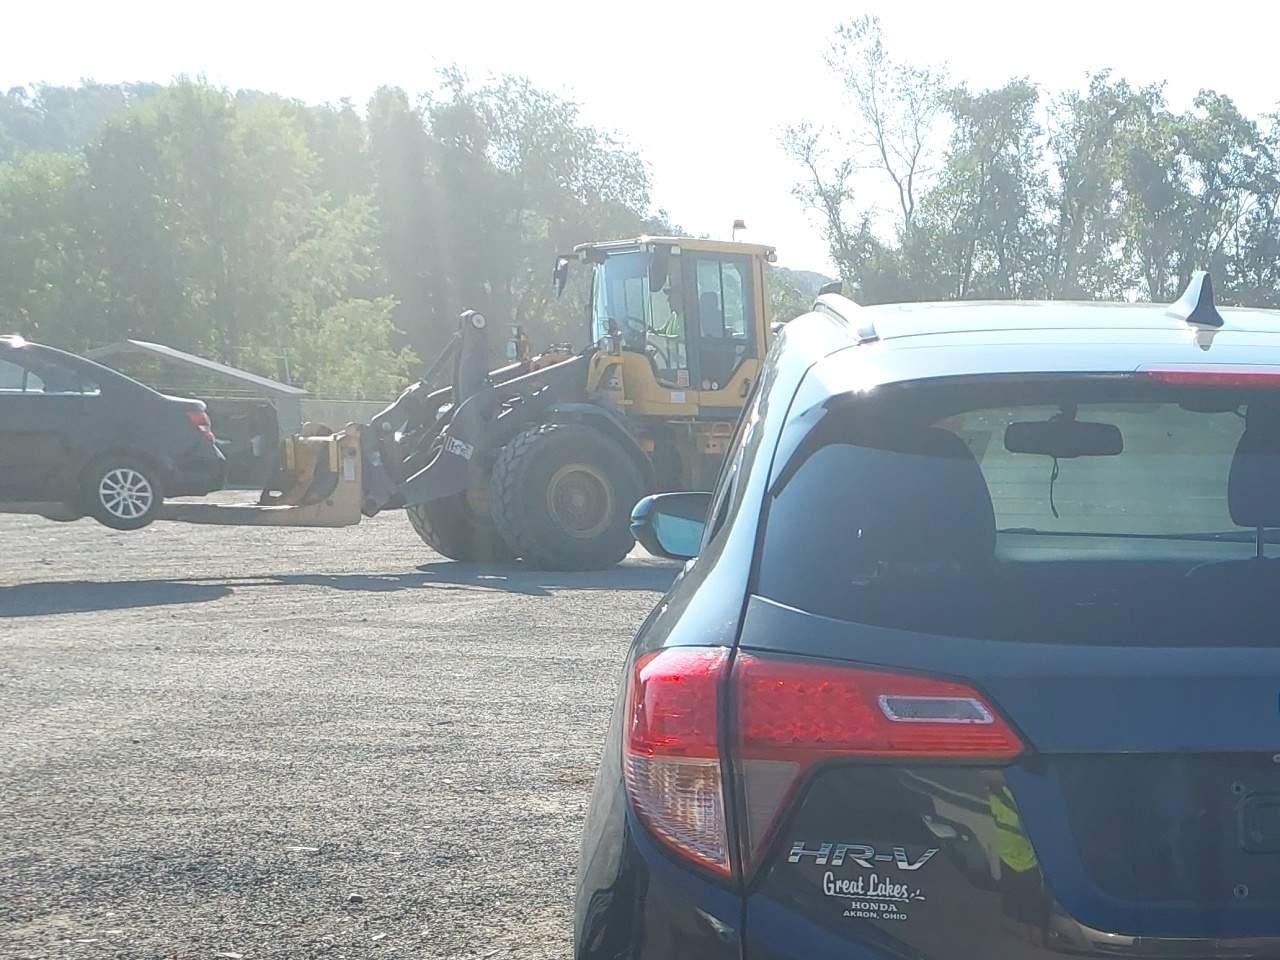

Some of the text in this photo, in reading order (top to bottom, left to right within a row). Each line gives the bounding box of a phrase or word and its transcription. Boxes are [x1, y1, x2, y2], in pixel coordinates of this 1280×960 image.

[788, 841, 939, 870] HR-V
[823, 871, 908, 898] Great Lakes
[843, 910, 907, 920] AKRON, OHIO
[851, 901, 898, 912] HONDA
